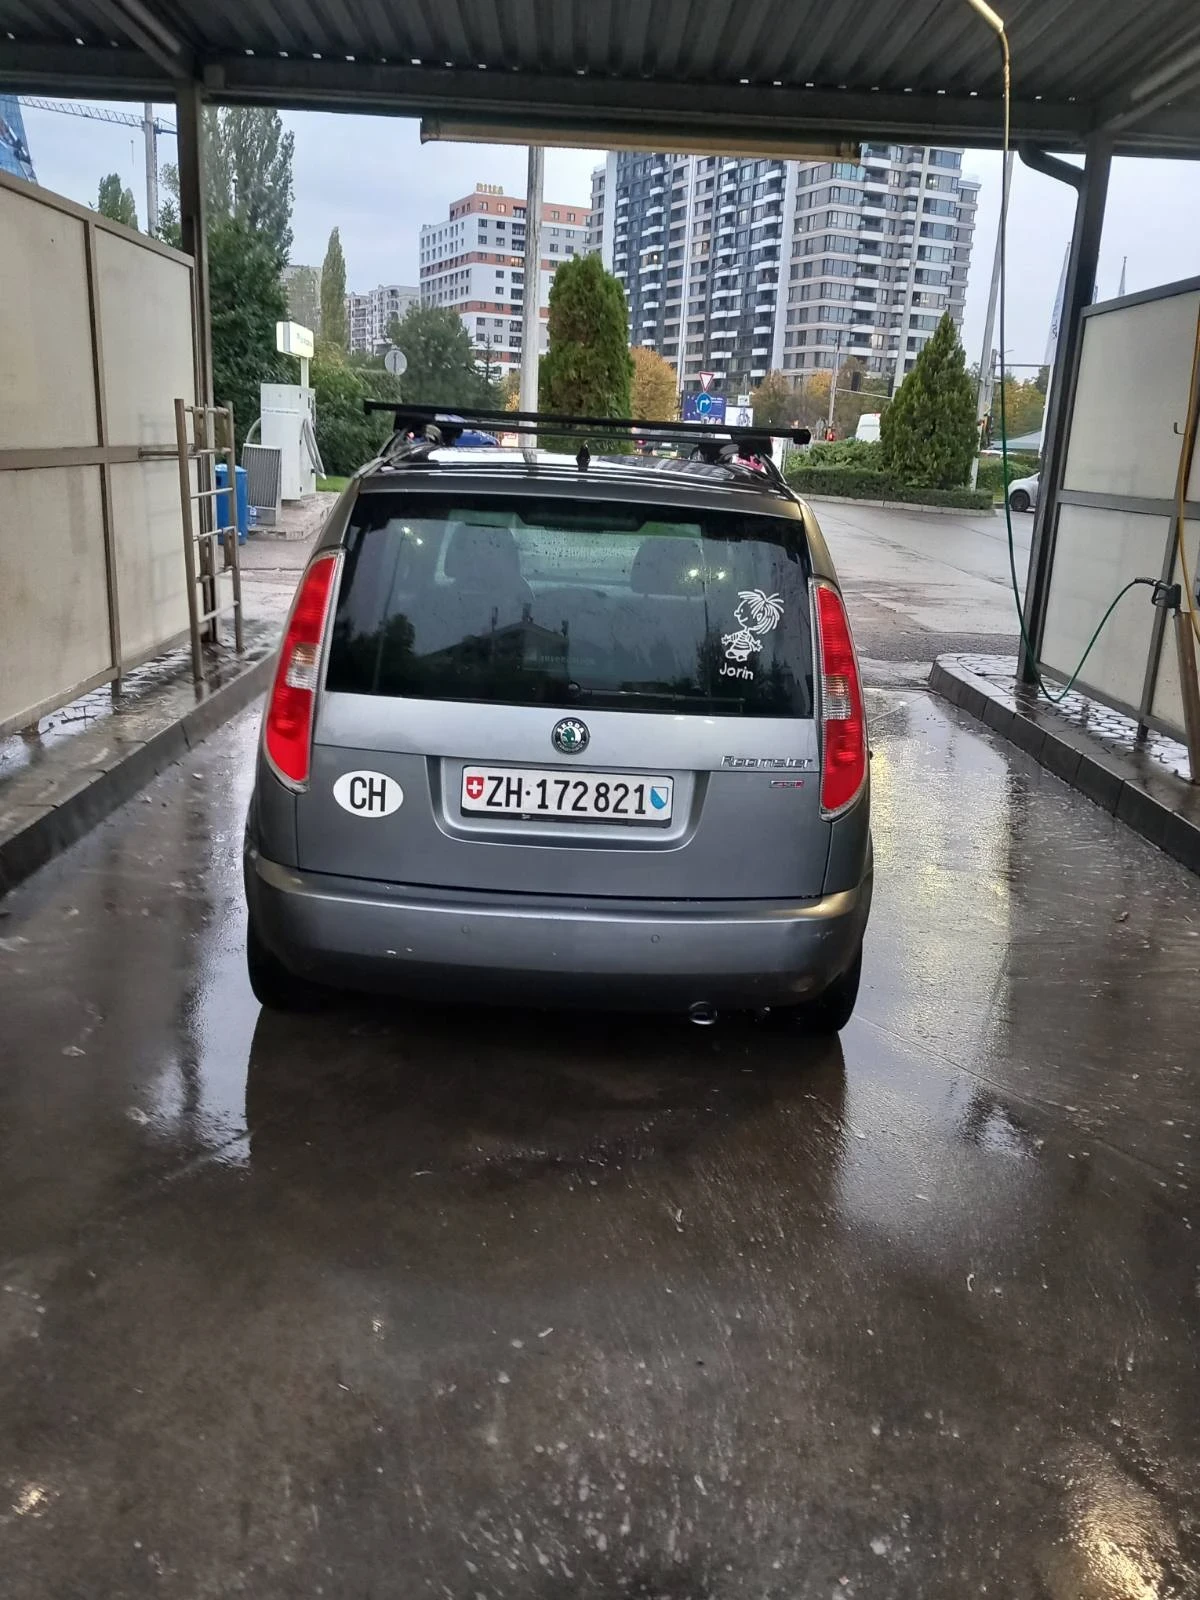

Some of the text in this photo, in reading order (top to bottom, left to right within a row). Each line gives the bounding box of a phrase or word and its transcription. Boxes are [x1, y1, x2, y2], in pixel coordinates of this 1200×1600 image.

[719, 662, 754, 680] Jorin
[720, 755, 813, 769] Roomster
[349, 776, 386, 812] CH
